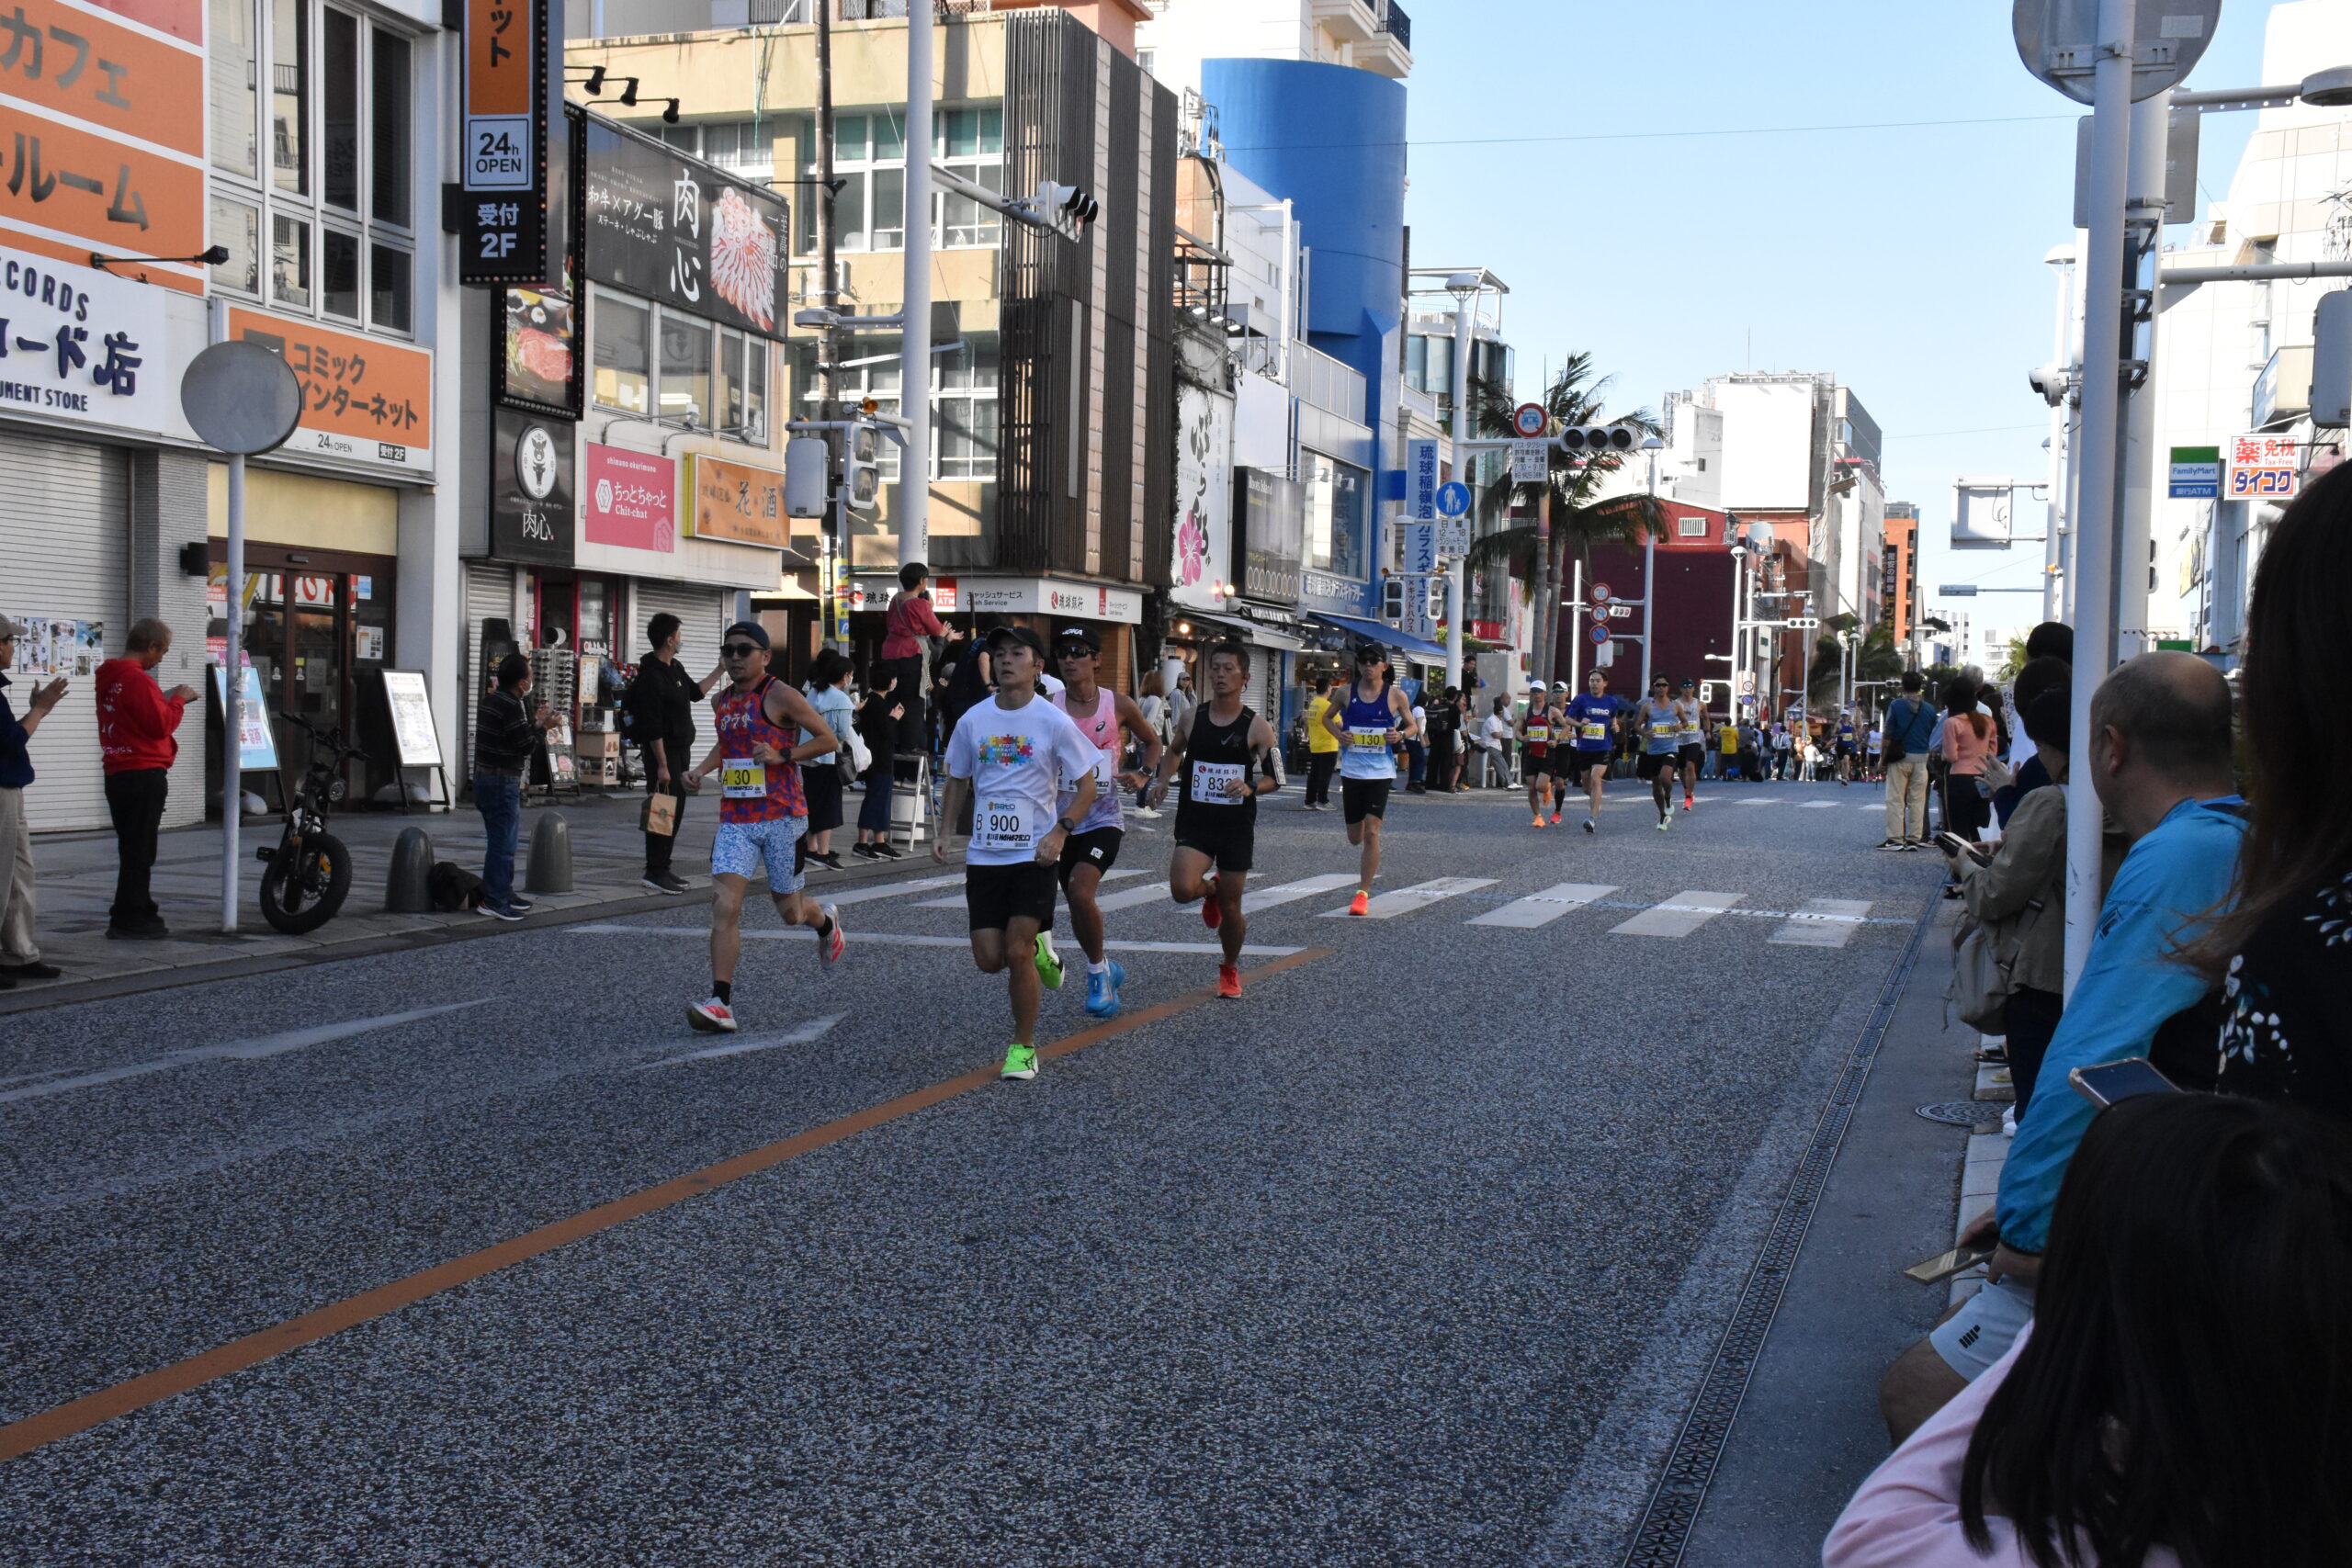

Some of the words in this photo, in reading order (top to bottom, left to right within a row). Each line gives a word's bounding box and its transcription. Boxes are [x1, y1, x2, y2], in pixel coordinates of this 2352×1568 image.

[490, 0, 513, 67] ット
[479, 132, 519, 156] 24h
[475, 158, 522, 173] OPEN
[0, 131, 150, 231] ルーム
[477, 203, 519, 227] 受付
[480, 233, 517, 258] 2F
[670, 168, 702, 302] 肉心
[0, 257, 89, 321] CORDS
[293, 343, 366, 385] コミック
[46, 389, 88, 412] STORE
[334, 442, 353, 453] OPEN
[394, 446, 405, 459] 2F
[2235, 437, 2262, 465] 薬
[2264, 439, 2296, 457] 免税
[2172, 467, 2216, 476] FamilyMart
[2264, 457, 2294, 466] Tax-Free
[2234, 470, 2291, 493] ダイコク
[614, 481, 666, 509] ちっとちゃっと
[615, 504, 648, 519] Chit-chat
[522, 510, 551, 541] 肉心
[1361, 735, 1380, 745] 130
[734, 770, 751, 785] 30
[1193, 774, 1201, 788] B
[976, 813, 983, 831] B
[989, 814, 1020, 832] 900
